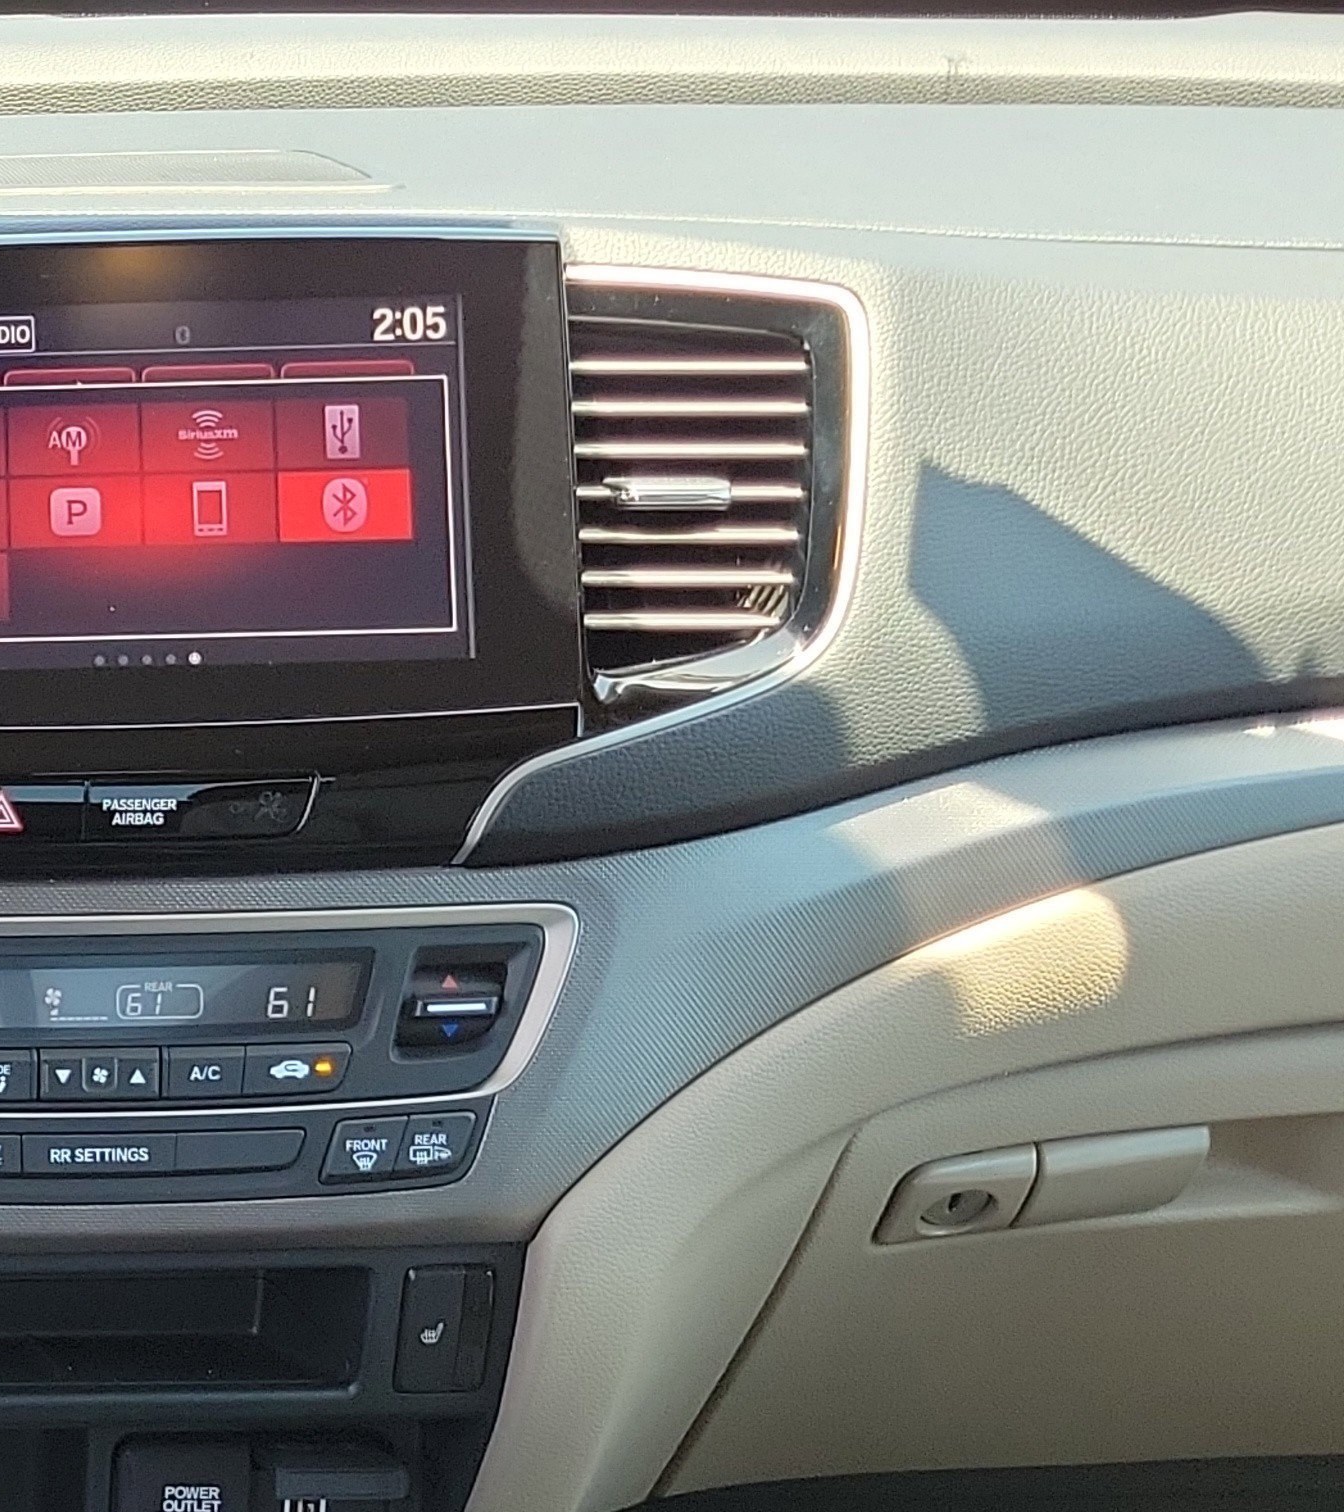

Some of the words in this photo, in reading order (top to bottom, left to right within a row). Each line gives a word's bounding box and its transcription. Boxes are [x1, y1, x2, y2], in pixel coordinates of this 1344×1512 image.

[372, 305, 447, 341] 2:05
[102, 798, 178, 811] PASSENGER
[111, 812, 164, 826] AIRBAG
[125, 992, 162, 1016] 61
[266, 986, 315, 1019] 61
[189, 1066, 222, 1081] A/C
[345, 1139, 388, 1152] FRONT
[414, 1133, 448, 1146] REAR
[49, 1149, 72, 1163] RR
[74, 1147, 150, 1163] SETTINGS
[164, 1485, 221, 1500] POWER
[162, 1499, 222, 1512] OUTLET
